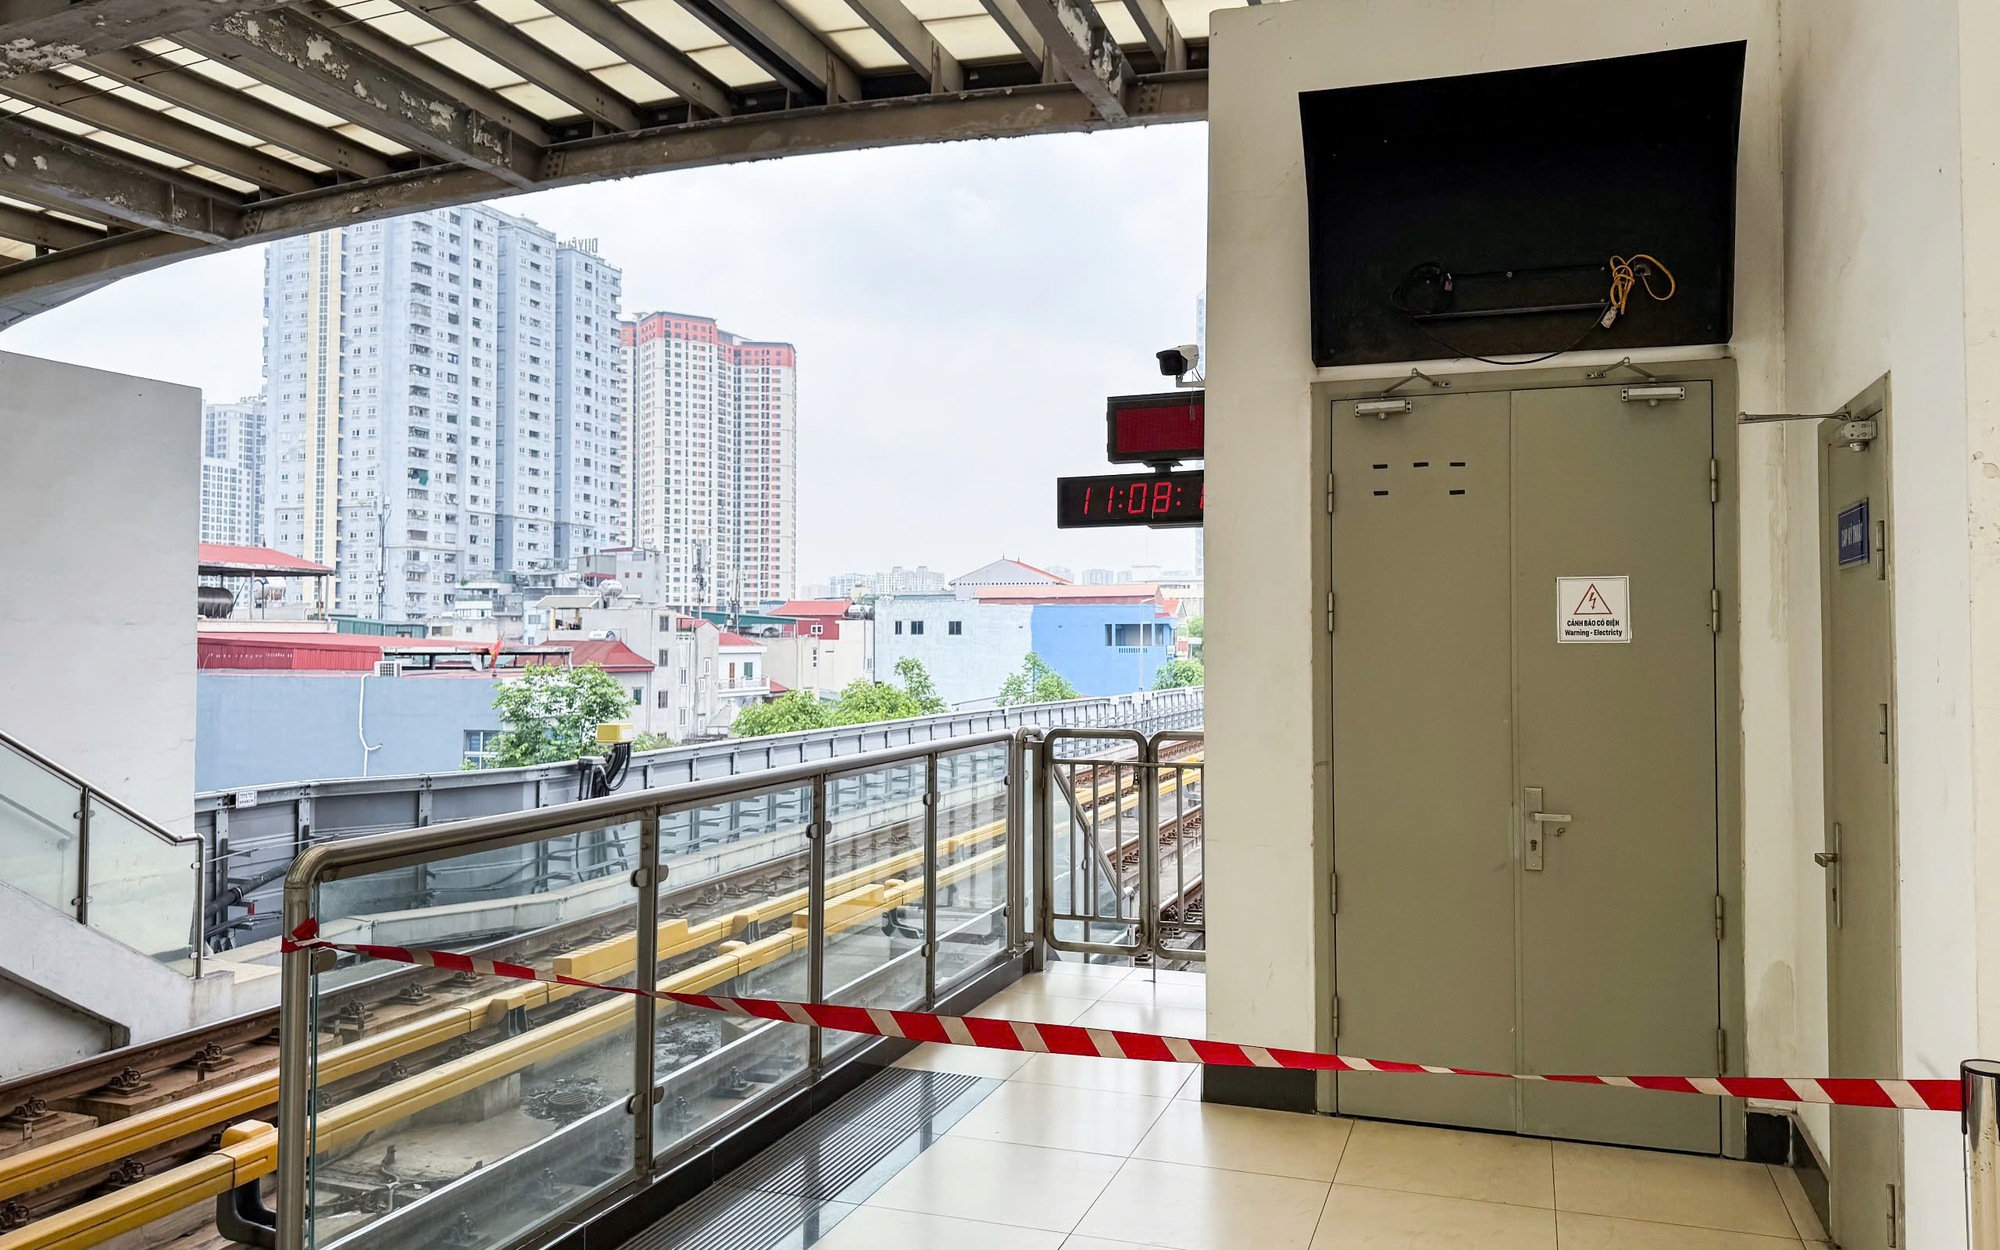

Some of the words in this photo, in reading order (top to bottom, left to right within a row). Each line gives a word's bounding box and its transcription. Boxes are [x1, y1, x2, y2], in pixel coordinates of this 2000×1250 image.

[1584, 618, 1596, 626] BÁO
[1596, 618, 1605, 626] CÓ
[1606, 618, 1619, 628] ĐIỆN
[1565, 629, 1589, 637] Warning
[1594, 629, 1622, 637] Electricty
